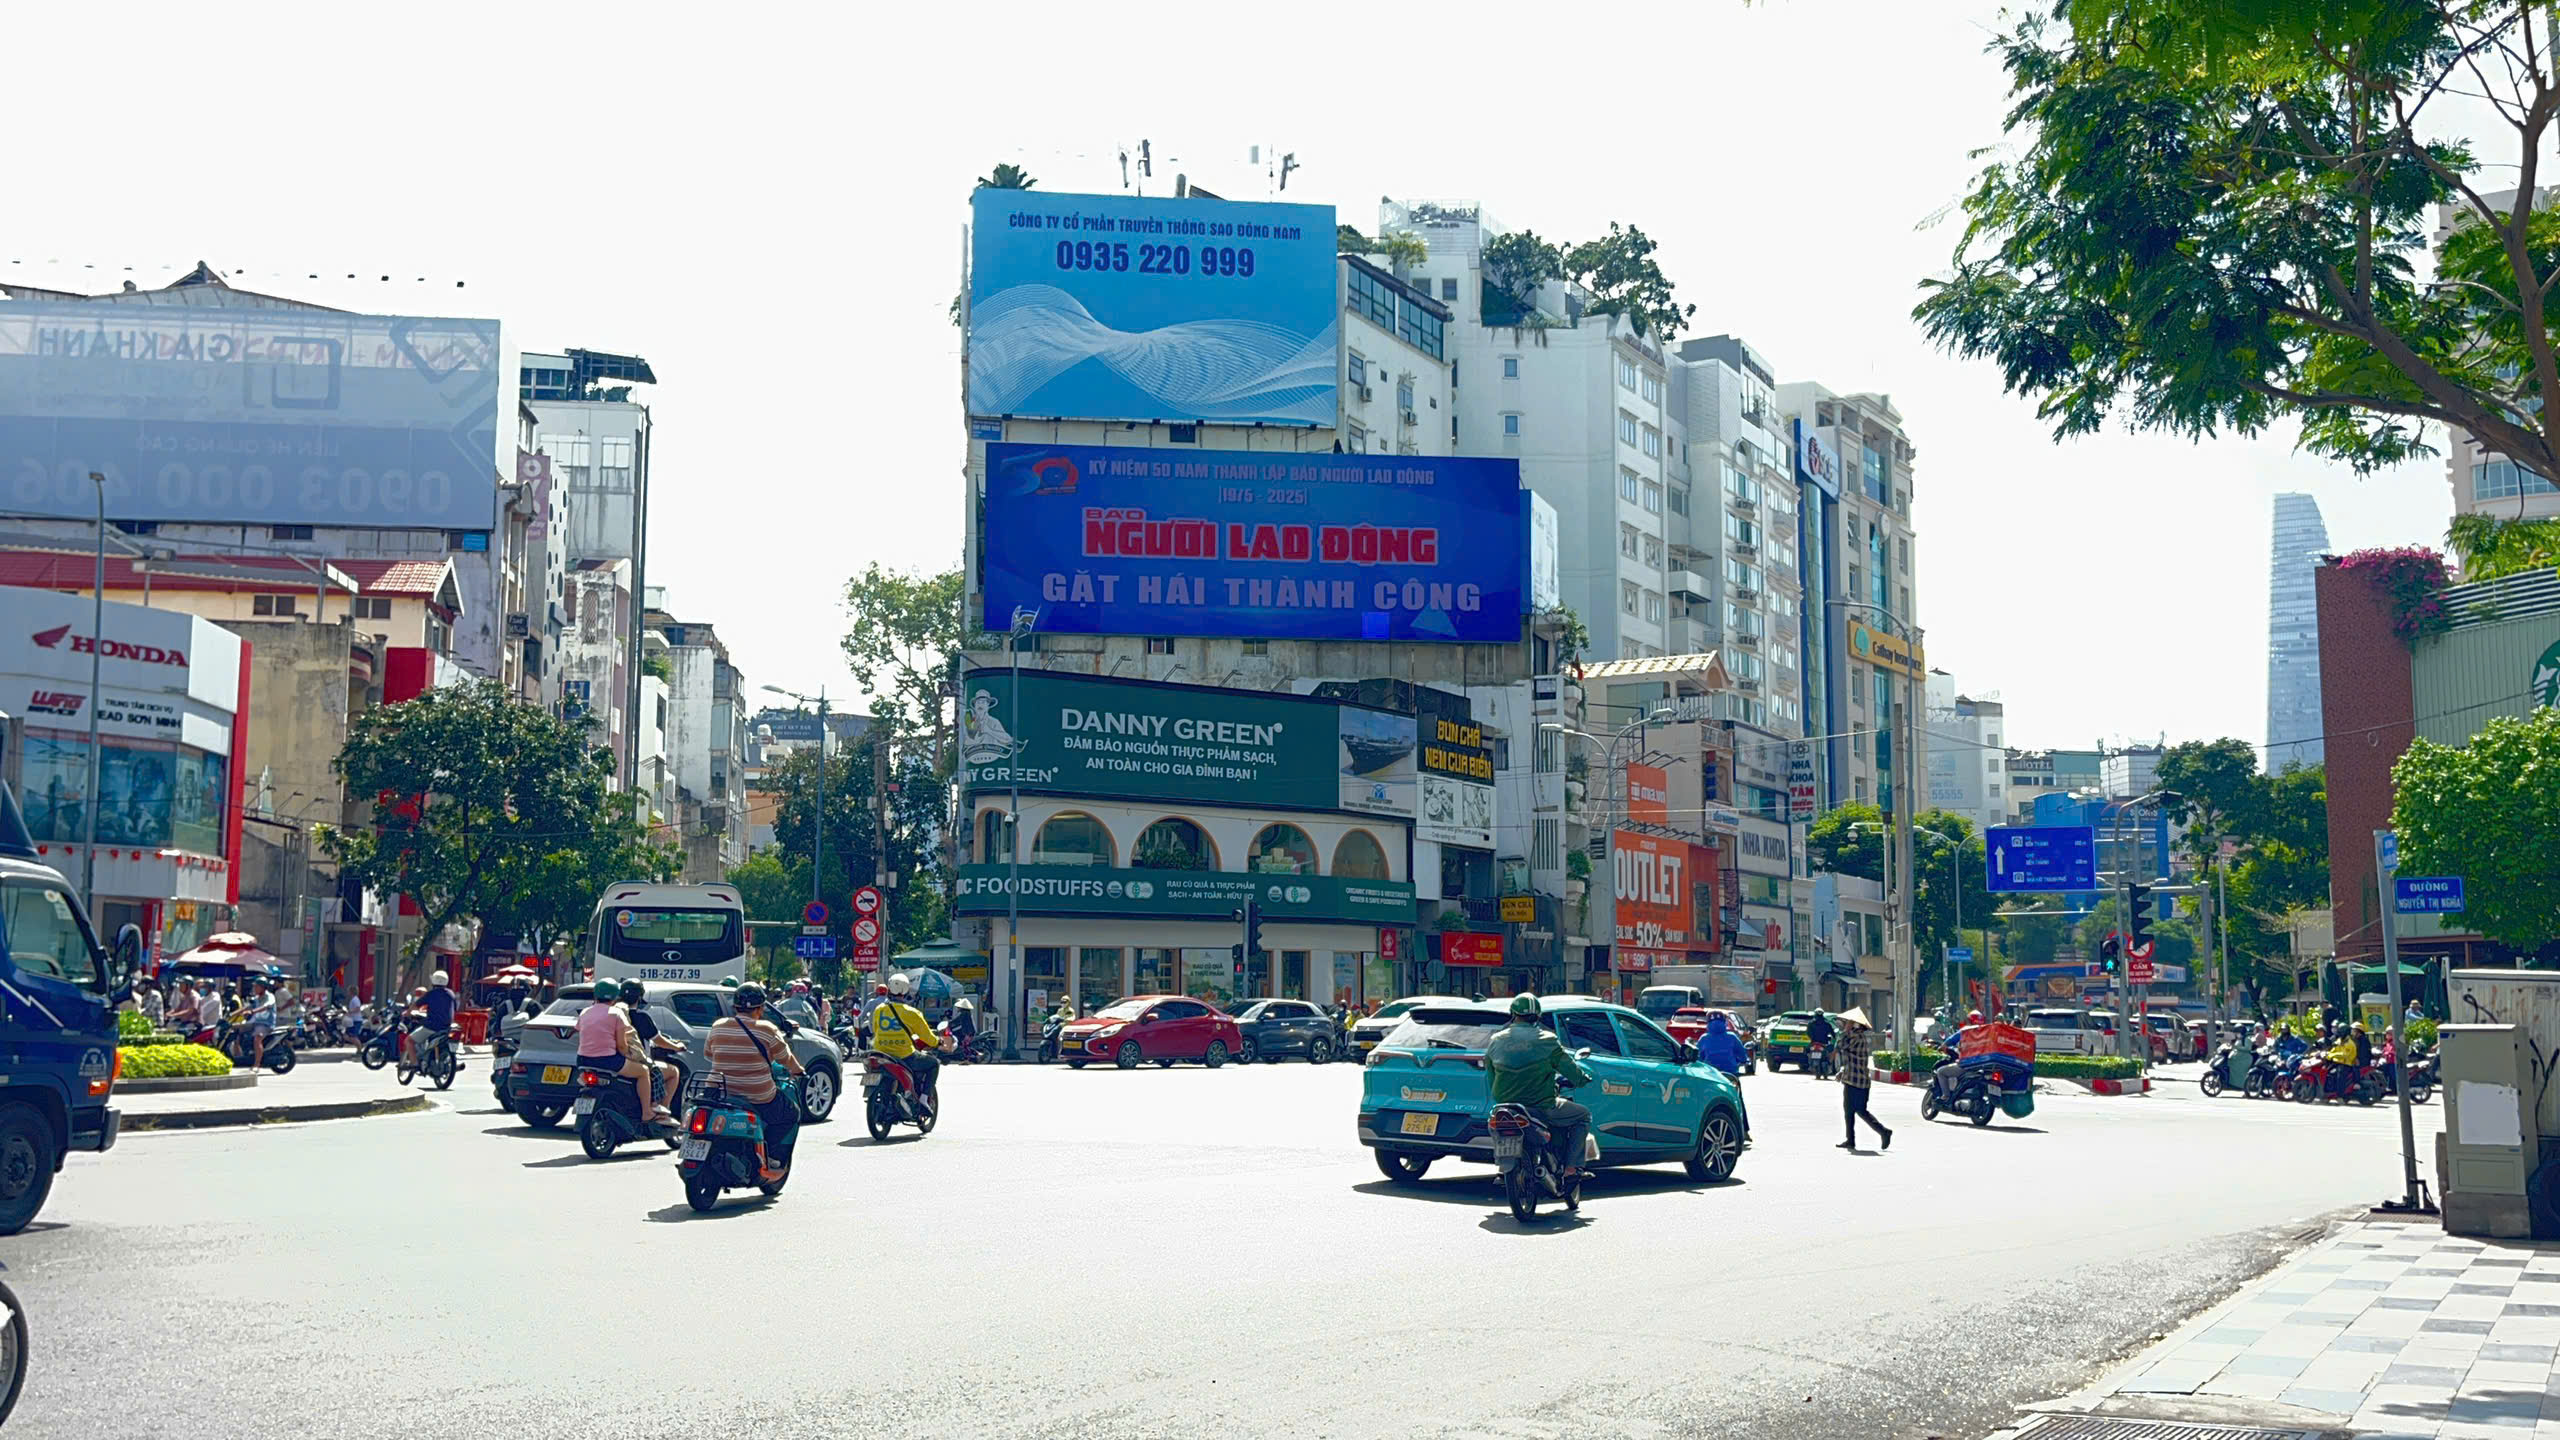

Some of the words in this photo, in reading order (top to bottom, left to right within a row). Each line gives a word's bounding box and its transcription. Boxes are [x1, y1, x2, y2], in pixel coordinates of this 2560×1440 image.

[1009, 212, 1042, 229] CÔNG
[1046, 215, 1060, 228] TY
[1063, 211, 1080, 230] CỔ
[1167, 219, 1206, 236] THÔNG
[1210, 223, 1233, 237] SAO
[1237, 222, 1269, 239] ĐÔNG
[1273, 226, 1301, 240] NAM
[1057, 240, 1129, 272] 0935
[1139, 244, 1190, 275] 220
[1200, 247, 1255, 278] 999
[1152, 462, 1171, 477] 50
[1084, 517, 1218, 559] NGƯỜI
[1227, 523, 1311, 561] LAO
[1319, 523, 1438, 566] ĐỘNG
[1043, 570, 1120, 607] GẶT
[1138, 573, 1205, 605] HÁI
[1224, 576, 1355, 608] THÀNH
[1374, 578, 1481, 611] CÔNG
[70, 634, 190, 668] HONDA
[1061, 708, 1168, 736] DANNY
[1173, 718, 1275, 747] GREEN
[1064, 735, 1092, 750] ĐẢM
[1095, 736, 1122, 752] BẢO
[1125, 739, 1168, 756] NGUỒN
[1171, 745, 1204, 760] THỰC
[1207, 745, 1240, 761] PHẨM
[1243, 751, 1277, 766] SẠCH,
[1425, 746, 1447, 770] NEM
[1448, 751, 1468, 774] CUA
[982, 767, 1052, 783] GREEN
[1086, 757, 1104, 769] AN
[1106, 757, 1139, 771] TOÀN
[1143, 762, 1170, 774] CHO
[1172, 763, 1193, 776] GIA
[1195, 762, 1223, 777] ĐÌNH
[1226, 768, 1251, 782] BẠN
[1788, 773, 1815, 783] KHOA
[1791, 760, 1811, 770] NHA
[1742, 831, 1760, 856] NHA
[1763, 835, 1787, 862] KHOA
[976, 877, 1104, 897] FOODSTUFFS
[1166, 880, 1182, 889] RAU
[1614, 847, 1681, 906] OUTLET
[2409, 881, 2449, 892] ĐƯỜNG
[1637, 921, 1663, 948] 50%
[879, 1011, 903, 1031] be
